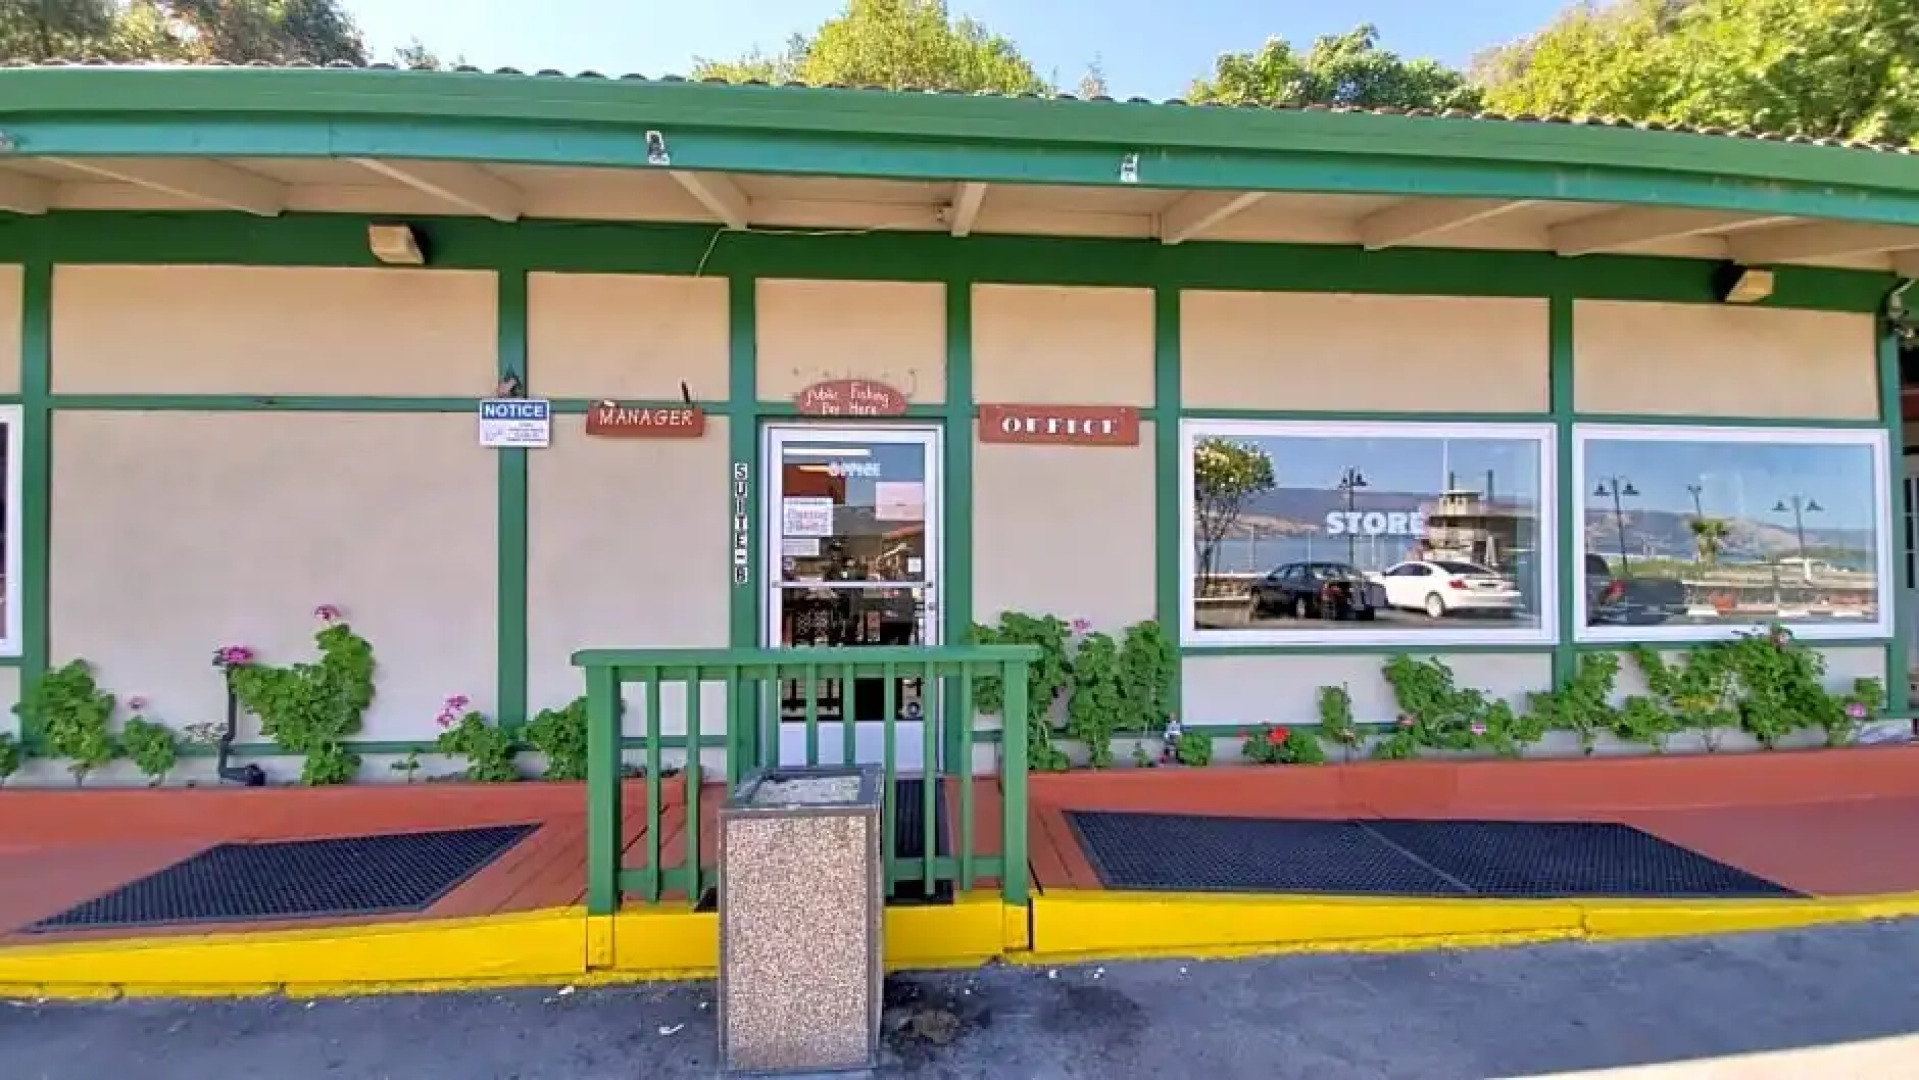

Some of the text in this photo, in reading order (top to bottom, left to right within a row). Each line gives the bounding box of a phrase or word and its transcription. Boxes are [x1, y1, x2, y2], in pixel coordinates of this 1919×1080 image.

[485, 403, 544, 418] NOTICE
[599, 407, 693, 426] MANAGER
[1326, 510, 1422, 534] STORE
